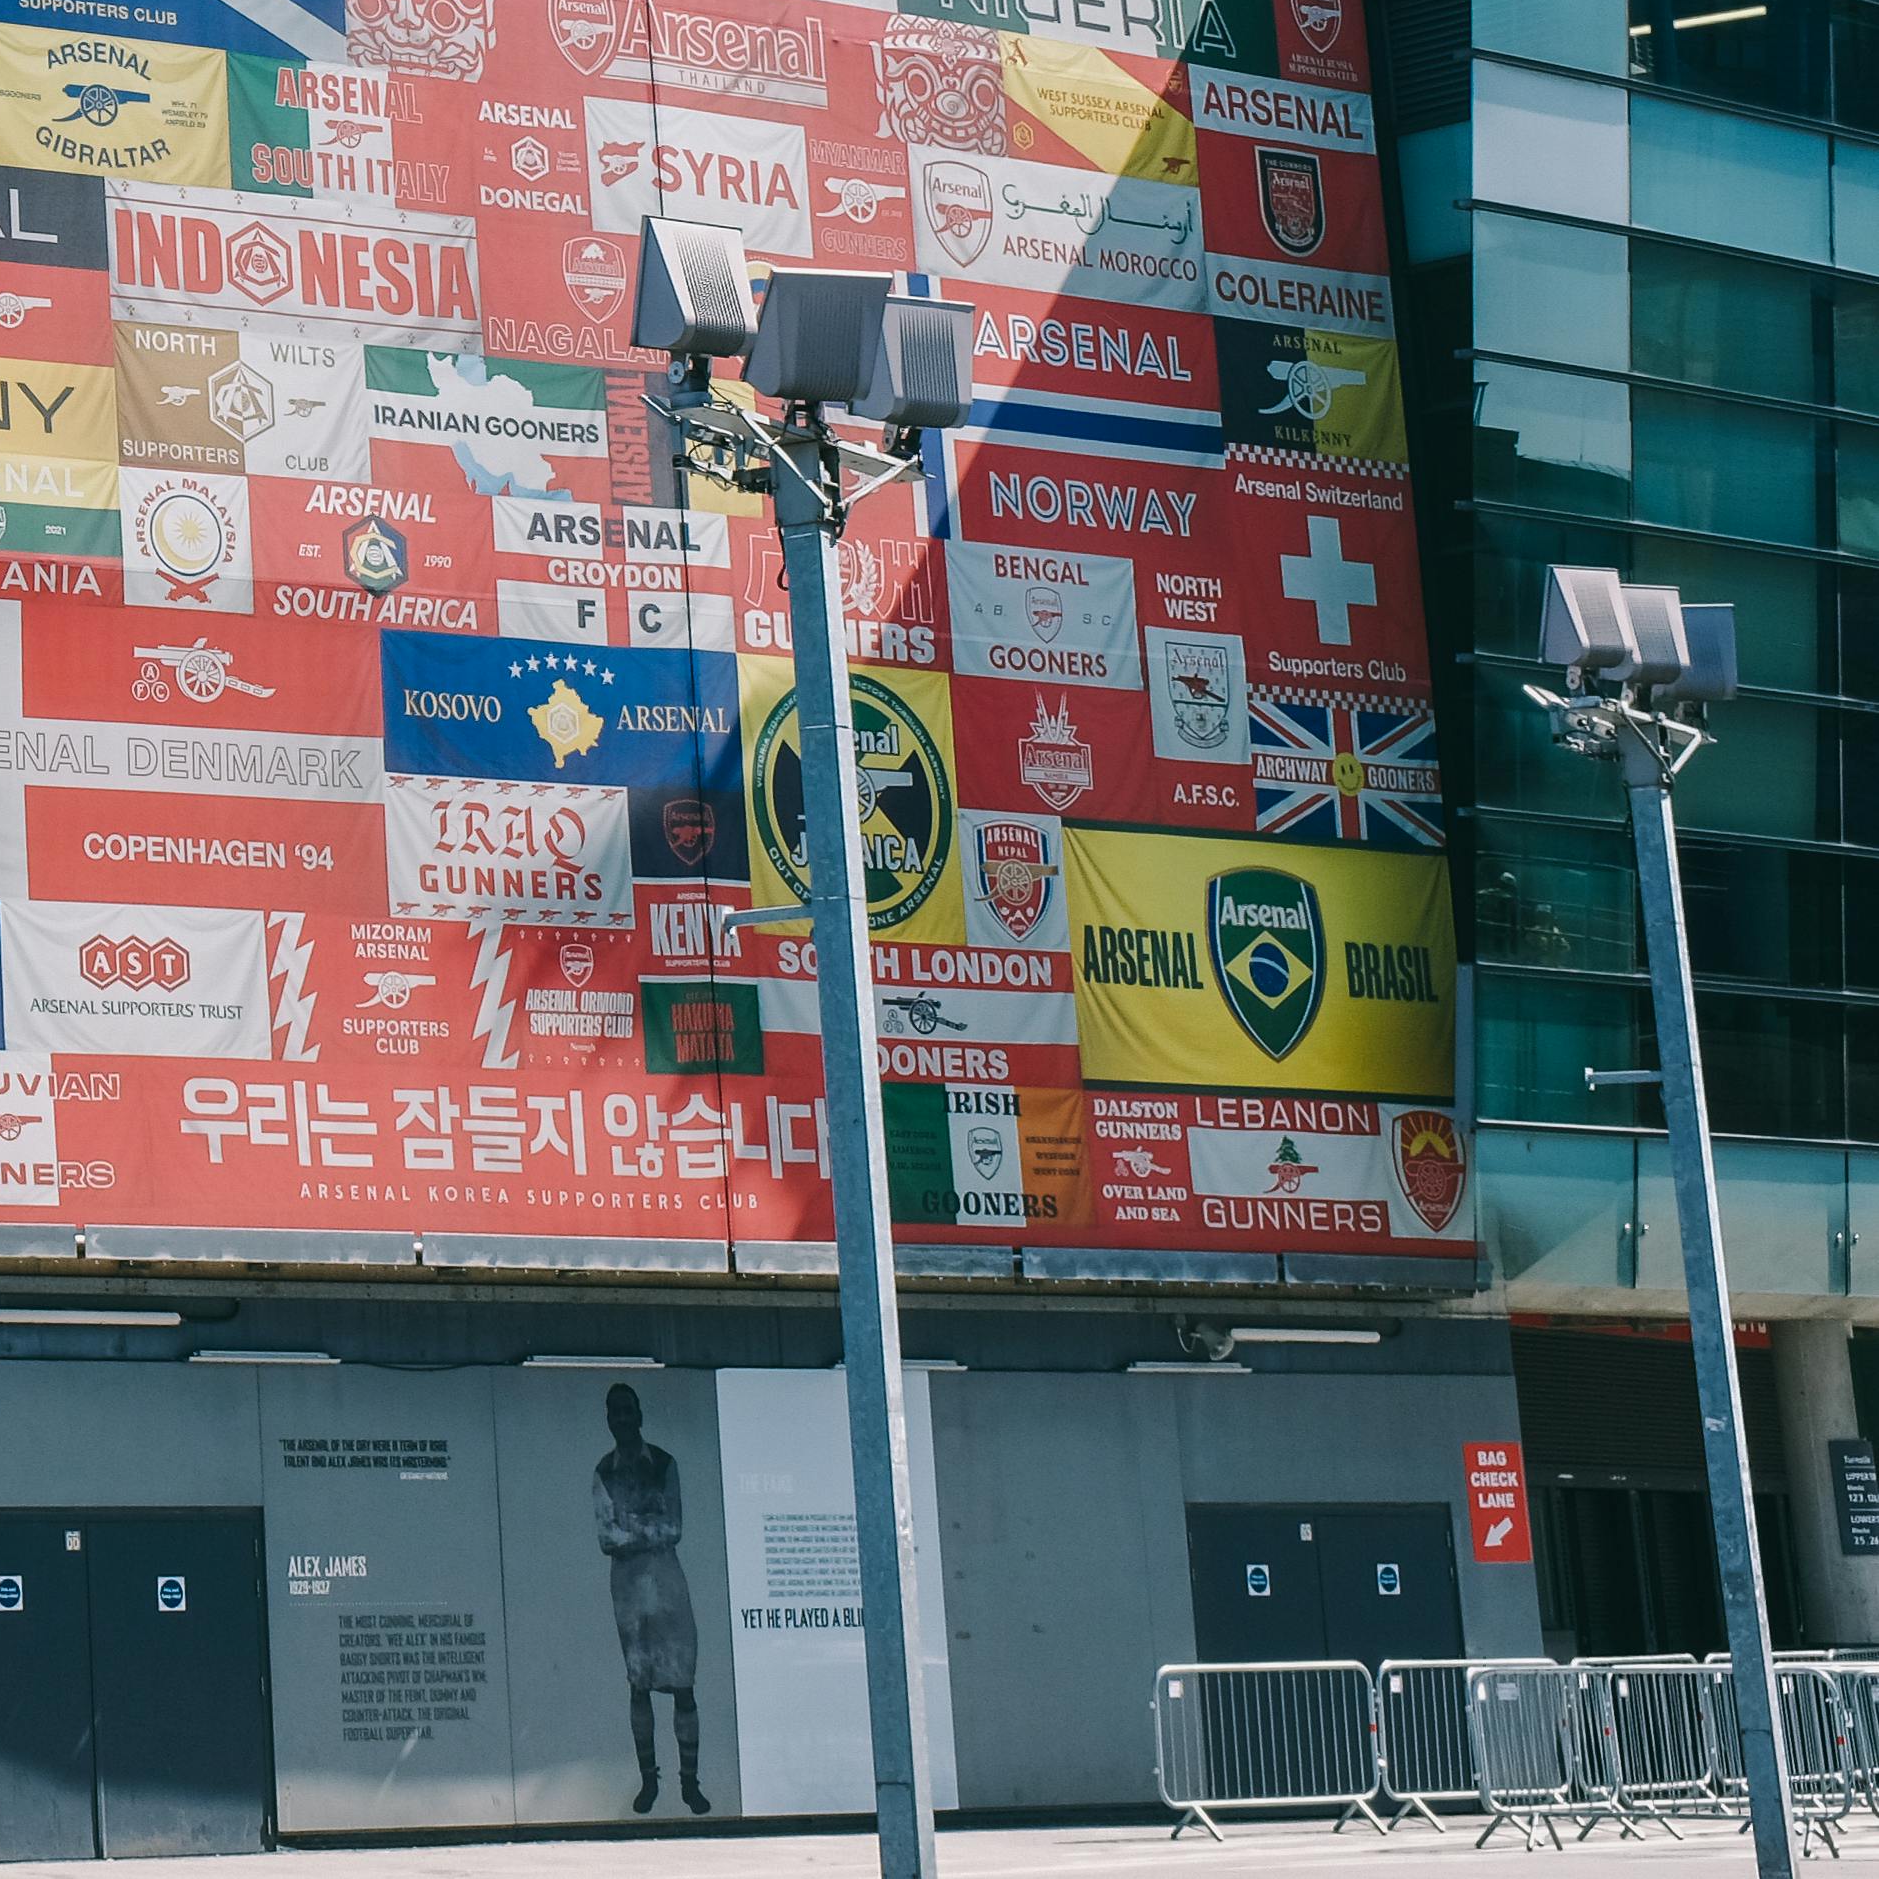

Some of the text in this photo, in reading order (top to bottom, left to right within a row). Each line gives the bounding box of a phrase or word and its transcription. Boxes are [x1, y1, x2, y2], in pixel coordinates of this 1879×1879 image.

[133, 5, 177, 26] CLUB
[47, 40, 151, 82] ARSENAL
[1202, 83, 1365, 141] ARSENAL
[36, 126, 171, 169] GIBRALTAR
[651, 144, 799, 211] SYRIA
[1003, 234, 1198, 282] ARSENAL MOROCCO
[1214, 275, 1385, 322] COLERAINE
[974, 314, 1192, 384] ARSENAL
[989, 470, 1196, 538] NORWAY
[1234, 473, 1402, 513] Arsenal Switzerland
[1268, 649, 1406, 683] Supporters Club
[1256, 752, 1436, 794] ARCHWAY GOONERS
[84, 833, 286, 870] COPENHAGEN
[1082, 924, 1204, 990] ARSENAL
[1345, 940, 1439, 1004] BRASIL
[180, 1076, 831, 1180] 우리는 잠들지 않습니다
[1472, 1471, 1518, 1488] CHECK
[1478, 1452, 1506, 1467] BAG
[1479, 1492, 1514, 1508] LANE
[288, 1555, 366, 1577] ALEX JAMES
